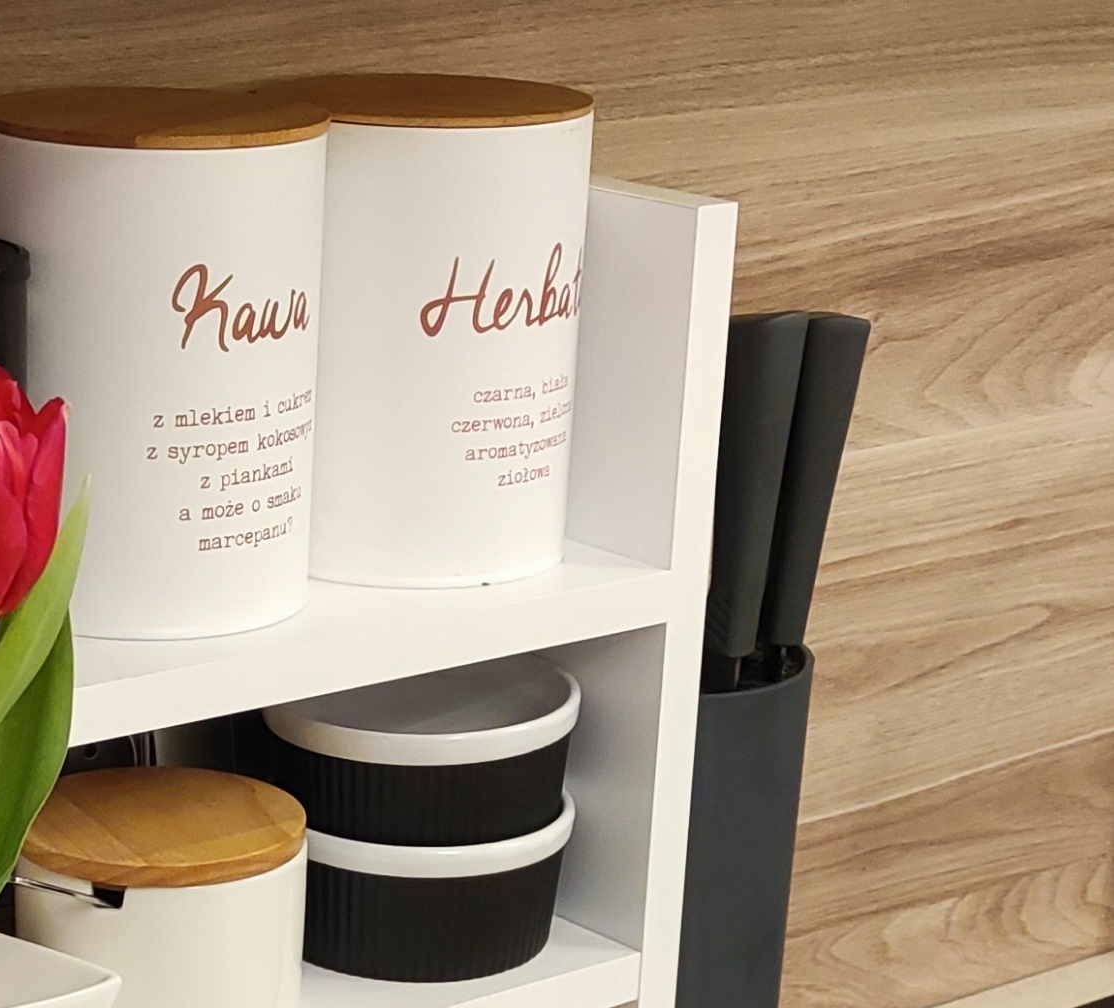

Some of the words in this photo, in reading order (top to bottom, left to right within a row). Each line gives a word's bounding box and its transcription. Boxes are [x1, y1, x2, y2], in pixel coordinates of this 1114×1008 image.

[420, 242, 583, 337] Herbat
[172, 263, 311, 353] Kawa
[473, 385, 536, 403] czarna,
[152, 414, 165, 429] z
[175, 405, 256, 428] mlekiem
[263, 399, 272, 418] i
[451, 414, 535, 433] czerwona,
[146, 446, 158, 460] z
[167, 440, 250, 465] syropem
[200, 475, 212, 489] z
[219, 455, 294, 492] piankami
[497, 465, 550, 487] ziołowa
[178, 507, 192, 521] a
[201, 500, 244, 520] może
[251, 498, 261, 513] o
[267, 485, 302, 509] smaku
[198, 515, 294, 551] marcepanu?
